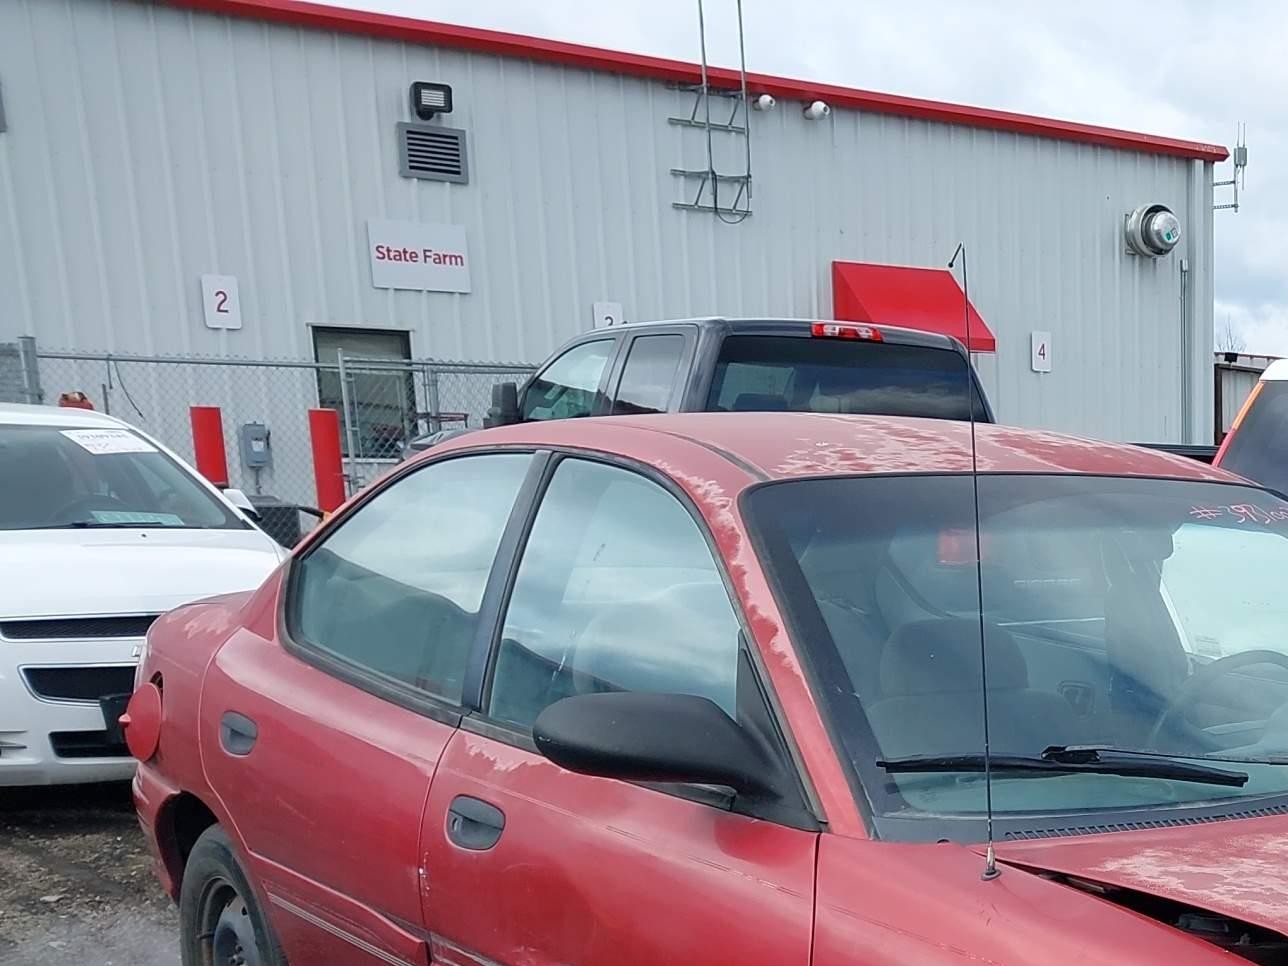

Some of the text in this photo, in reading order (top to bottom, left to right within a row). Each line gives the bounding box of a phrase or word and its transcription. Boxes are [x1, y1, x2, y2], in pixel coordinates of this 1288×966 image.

[375, 244, 465, 267] State Farm
[214, 290, 230, 313] 2
[1038, 343, 1045, 360] 4
